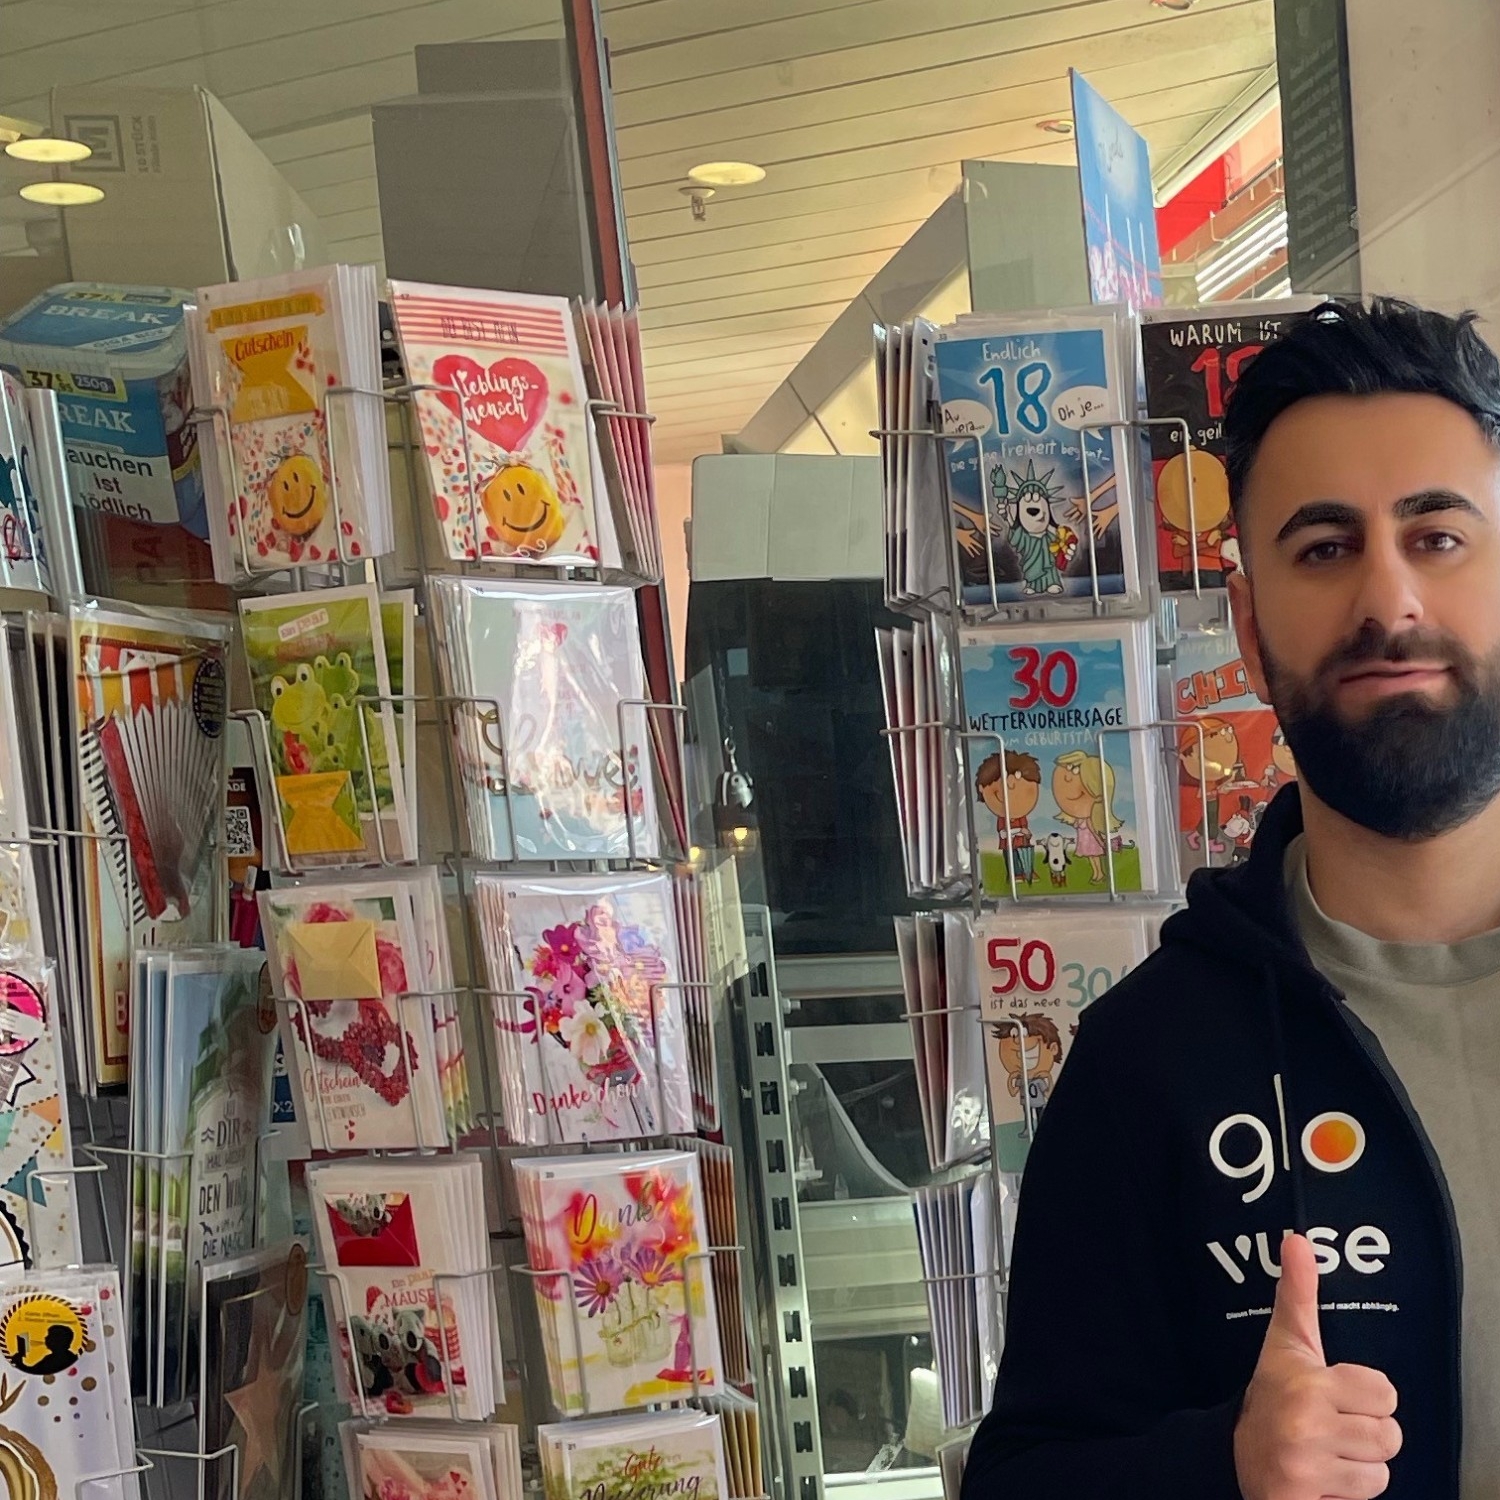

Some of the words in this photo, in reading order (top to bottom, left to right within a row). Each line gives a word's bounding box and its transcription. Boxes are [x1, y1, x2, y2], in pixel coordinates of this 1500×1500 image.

[43, 305, 170, 325] BREAK
[235, 329, 293, 361] Gutschein
[1170, 323, 1242, 346] WARUM
[1259, 321, 1282, 341] IST
[982, 340, 1041, 362] Endlich
[26, 371, 53, 388] 37
[75, 375, 111, 391] 250g
[978, 362, 1052, 435] 18
[60, 404, 135, 433] REAK
[1058, 407, 1076, 421] Oh
[1001, 438, 1057, 459] Freiheit
[95, 472, 122, 494] ist
[80, 491, 152, 521] tödlich
[1007, 645, 1079, 711] 30
[969, 707, 1124, 732] WETTERVORHERSAGE
[986, 936, 1057, 995] 50
[990, 996, 1005, 1010] ist
[1010, 996, 1028, 1009] das
[1033, 997, 1061, 1008] neue
[273, 1100, 294, 1114] X2
[216, 1118, 240, 1149] DIR
[1208, 1073, 1367, 1204] glo
[199, 1181, 222, 1217] DEN
[203, 1238, 218, 1261] DIE
[1320, 1302, 1336, 1311] und
[1336, 1301, 1361, 1311] macht
[1361, 1301, 1400, 1313] abhängig.
[624, 1446, 662, 1482] Gute
